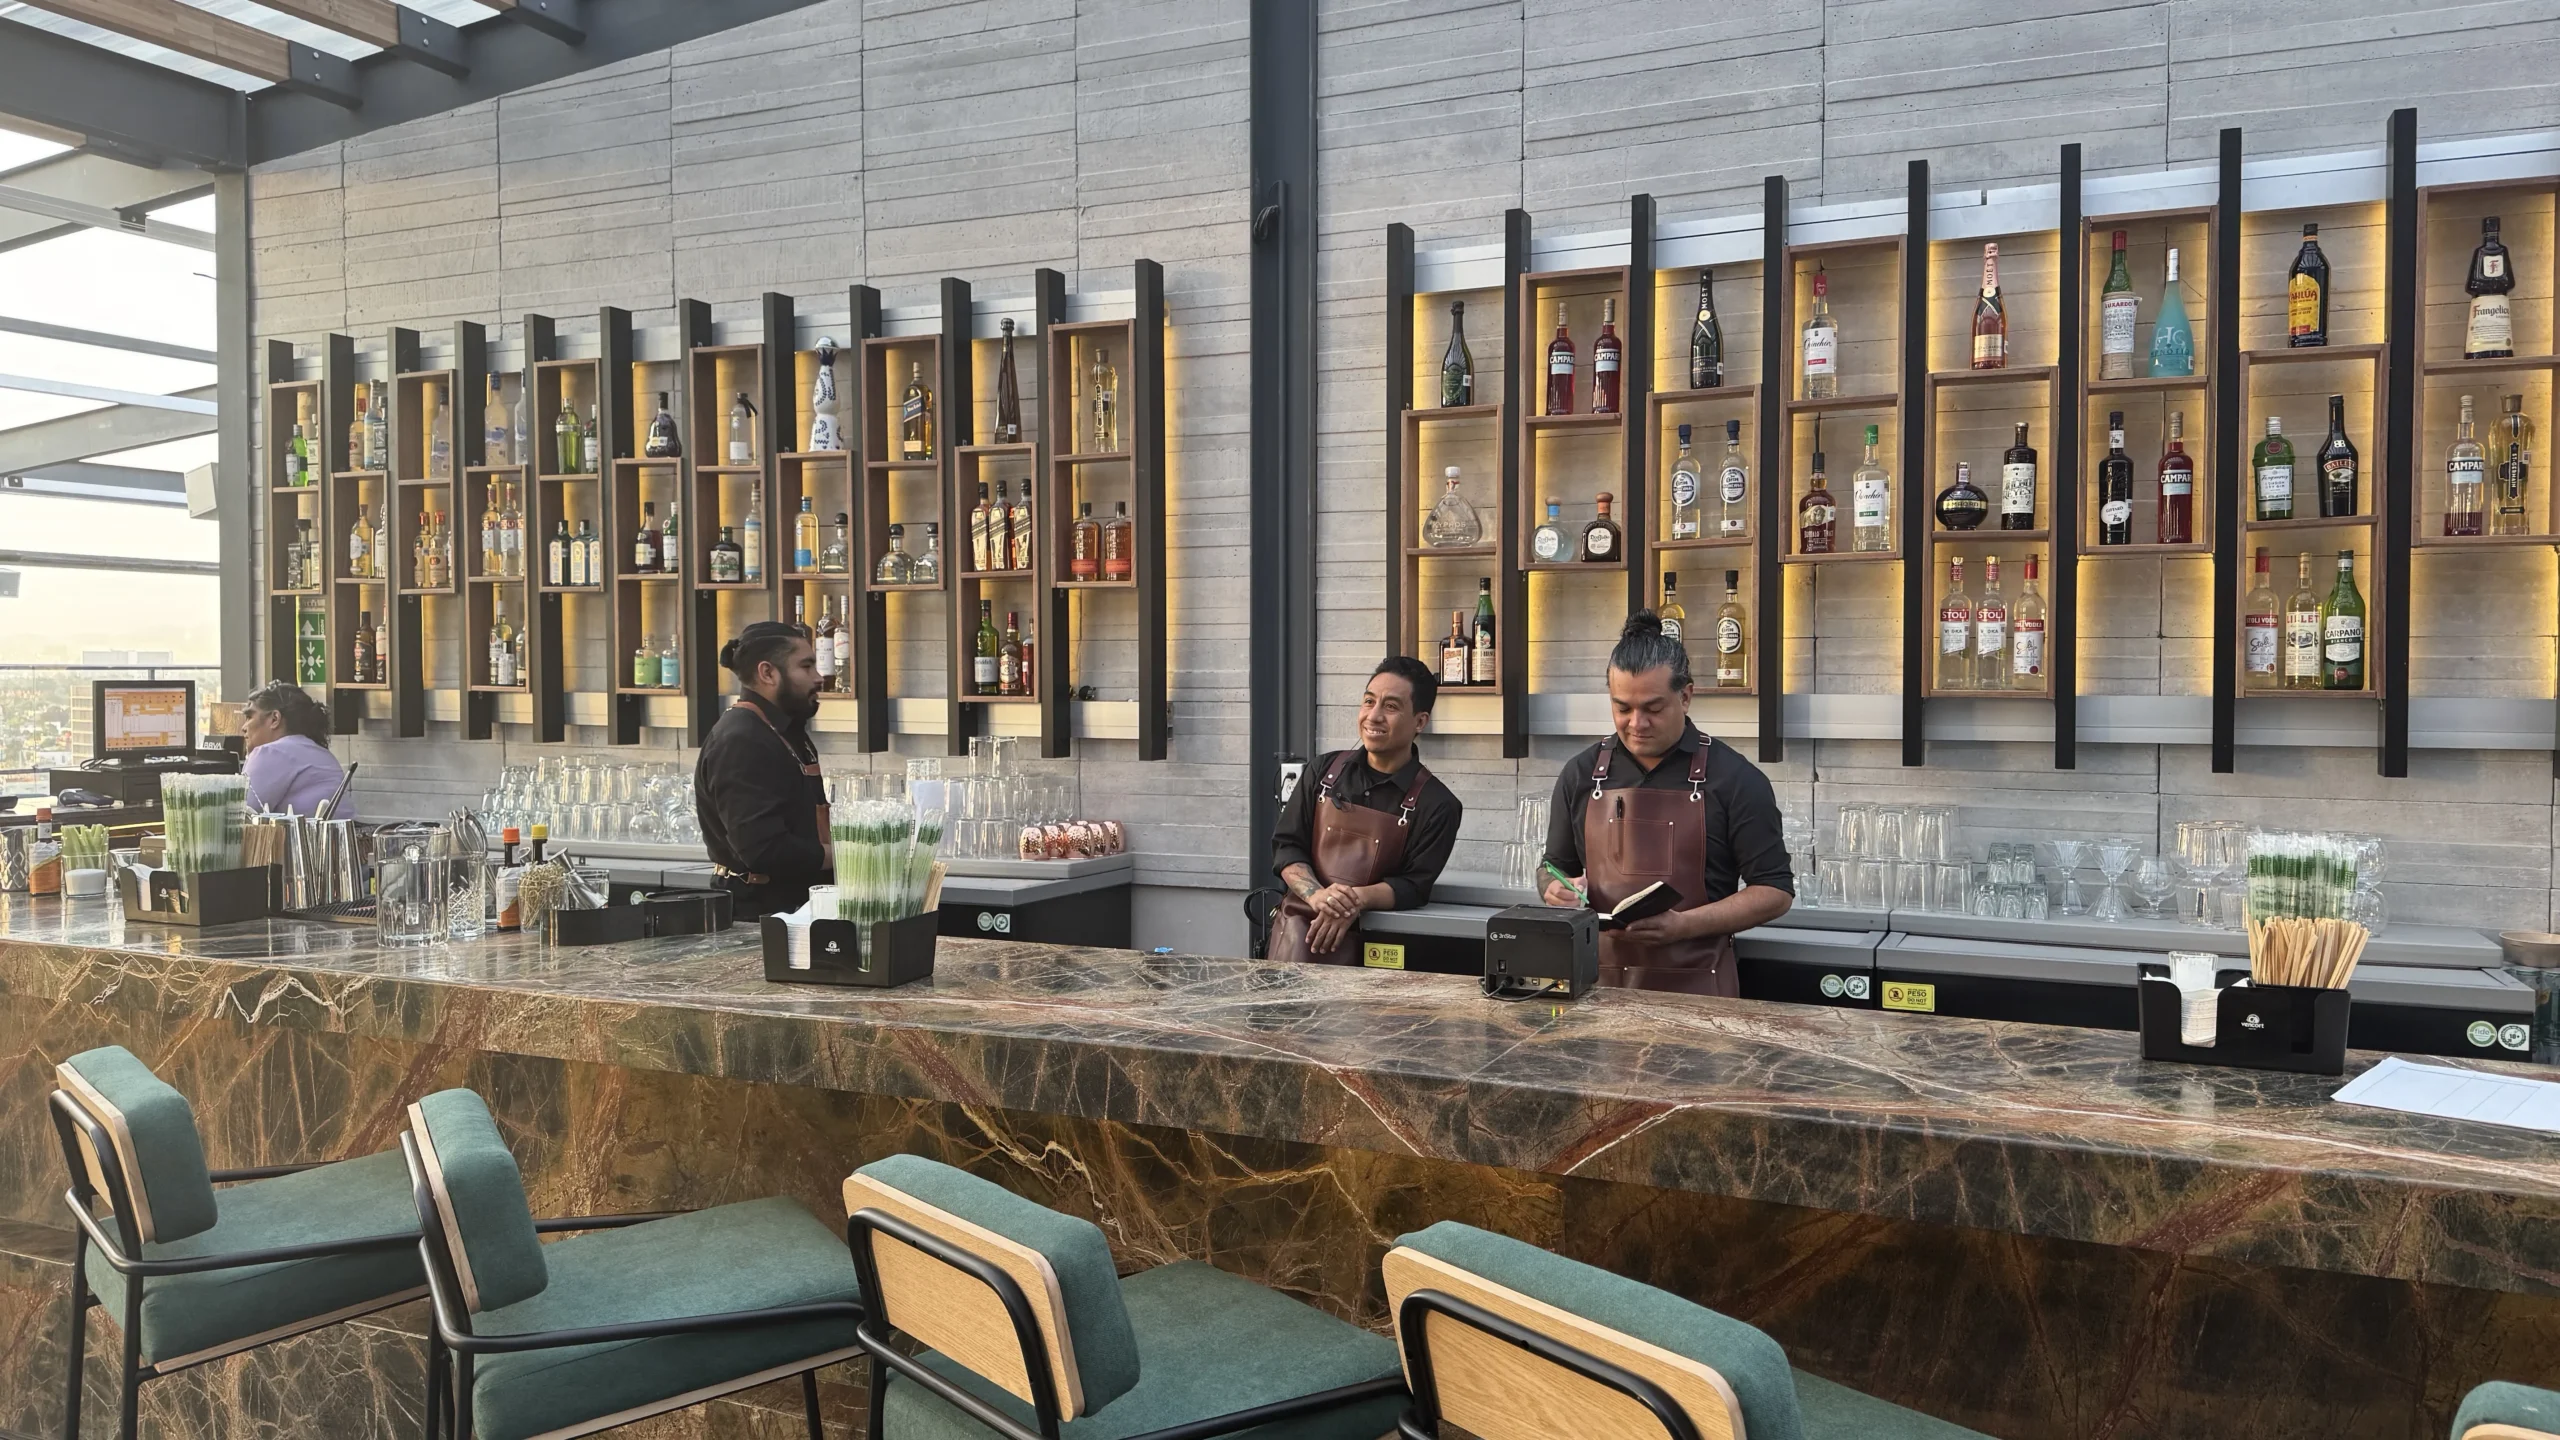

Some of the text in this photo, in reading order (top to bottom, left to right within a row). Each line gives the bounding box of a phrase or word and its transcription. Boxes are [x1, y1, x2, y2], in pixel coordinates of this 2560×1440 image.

[1550, 356, 1574, 364] CAMPAR
[1594, 352, 1620, 362] CAMPAR
[2448, 461, 2484, 472] CAMPAR
[2160, 474, 2192, 483] CAMPAR
[2326, 628, 2360, 638] CARPANO
